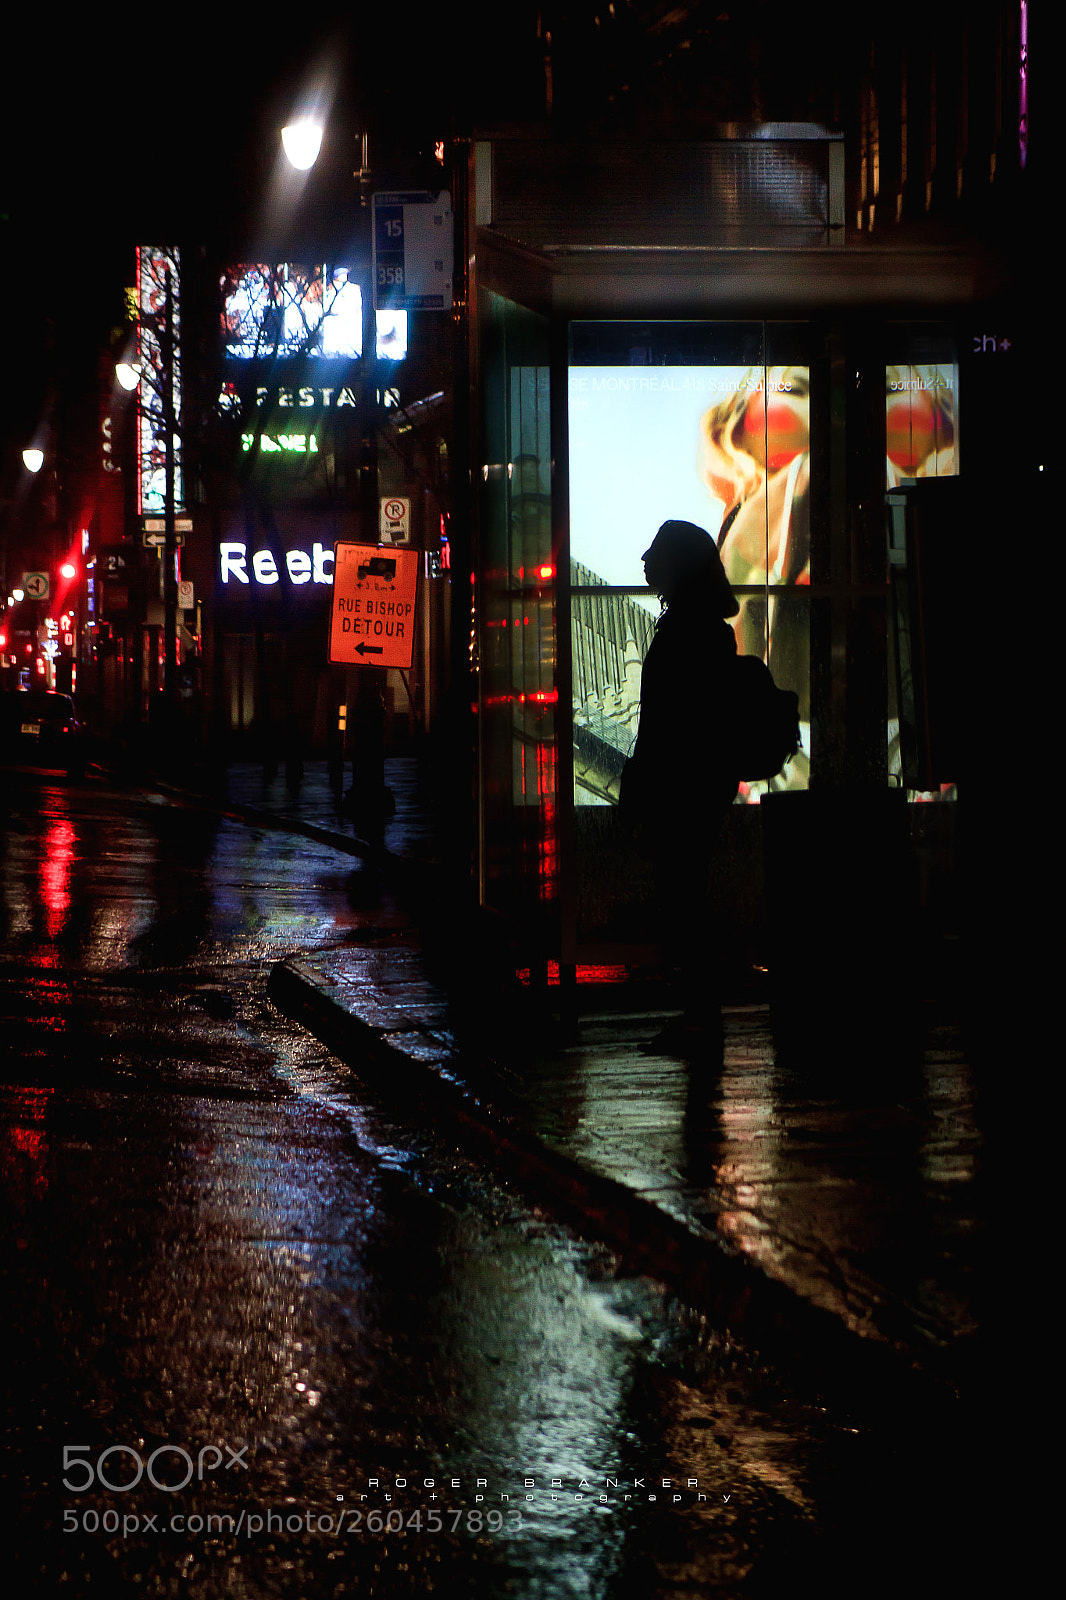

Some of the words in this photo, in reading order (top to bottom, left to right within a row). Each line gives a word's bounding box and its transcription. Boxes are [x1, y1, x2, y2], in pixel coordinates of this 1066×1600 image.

[385, 219, 402, 237] 15
[378, 267, 403, 285] 358
[338, 598, 361, 613] RUE
[366, 600, 412, 617] BISHOP
